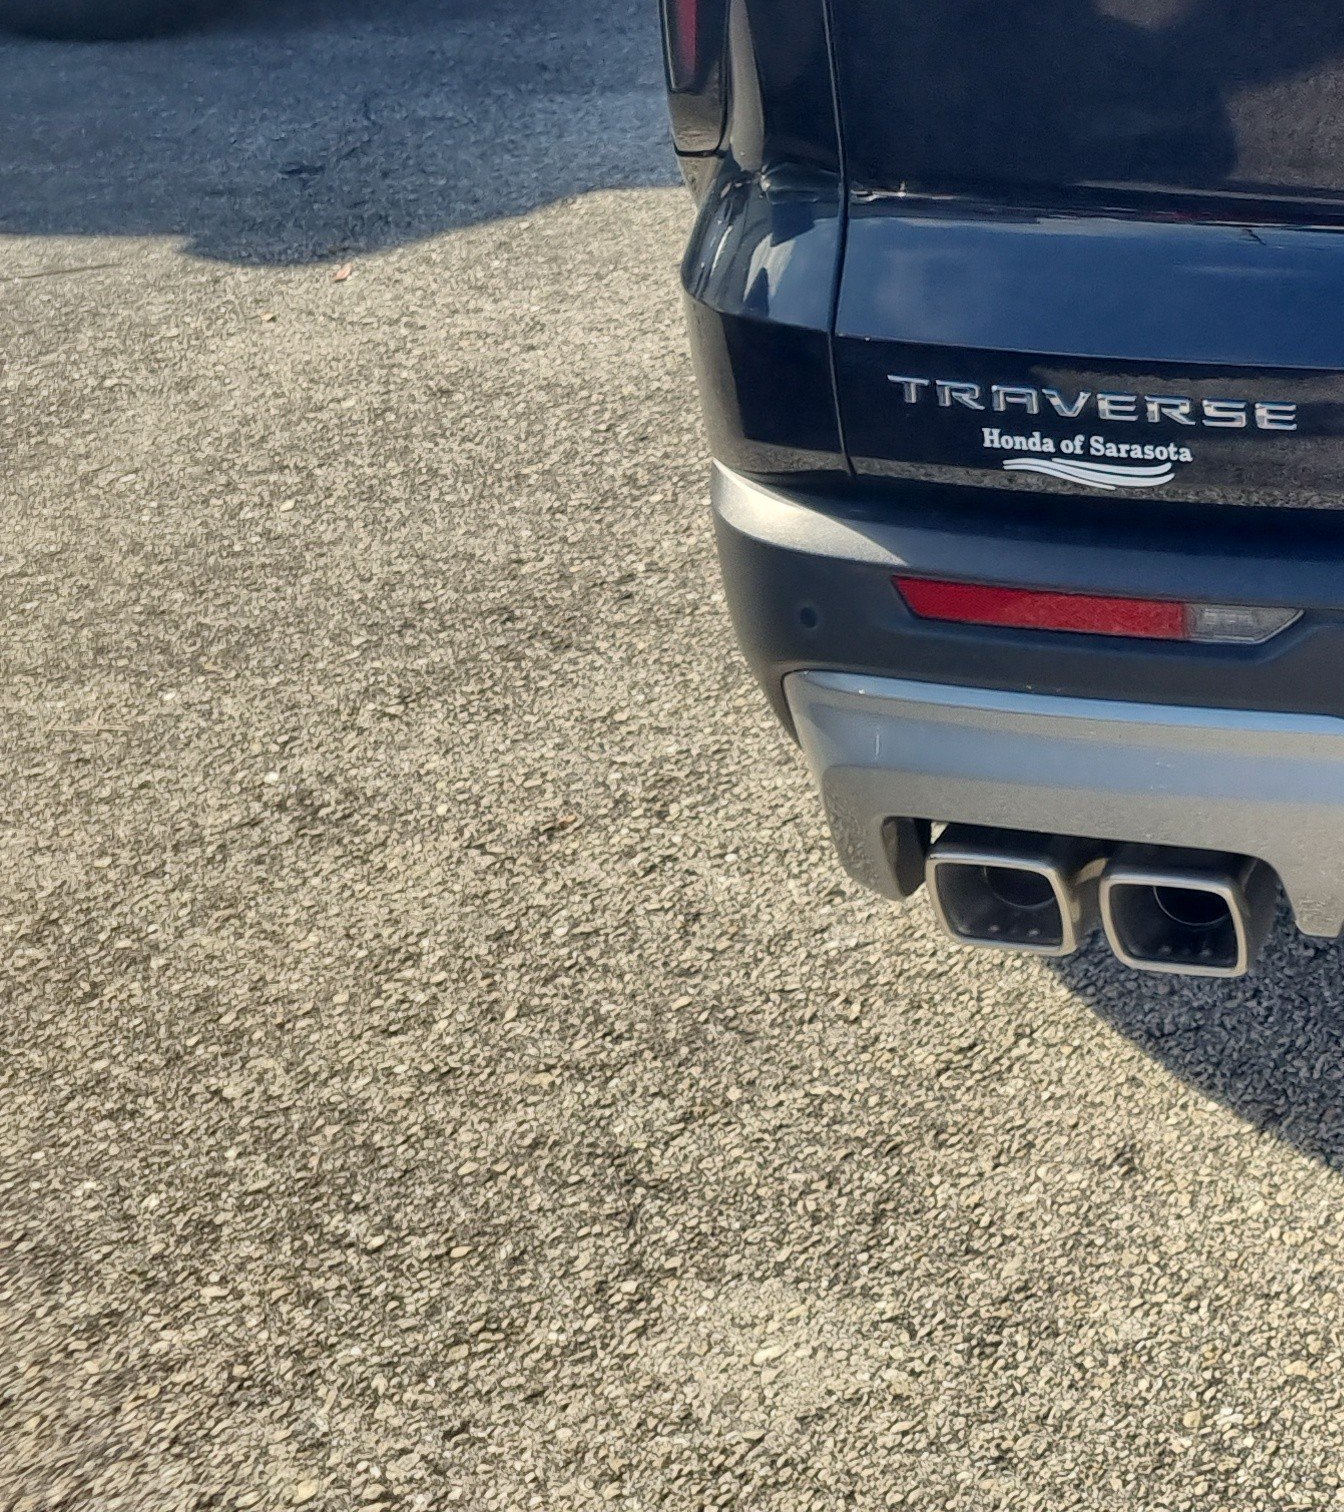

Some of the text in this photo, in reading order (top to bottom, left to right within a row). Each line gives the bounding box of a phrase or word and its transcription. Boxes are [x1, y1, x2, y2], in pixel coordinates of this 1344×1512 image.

[886, 373, 1298, 431] TRAVERSE
[982, 428, 1193, 463] Honda of Sarasota
